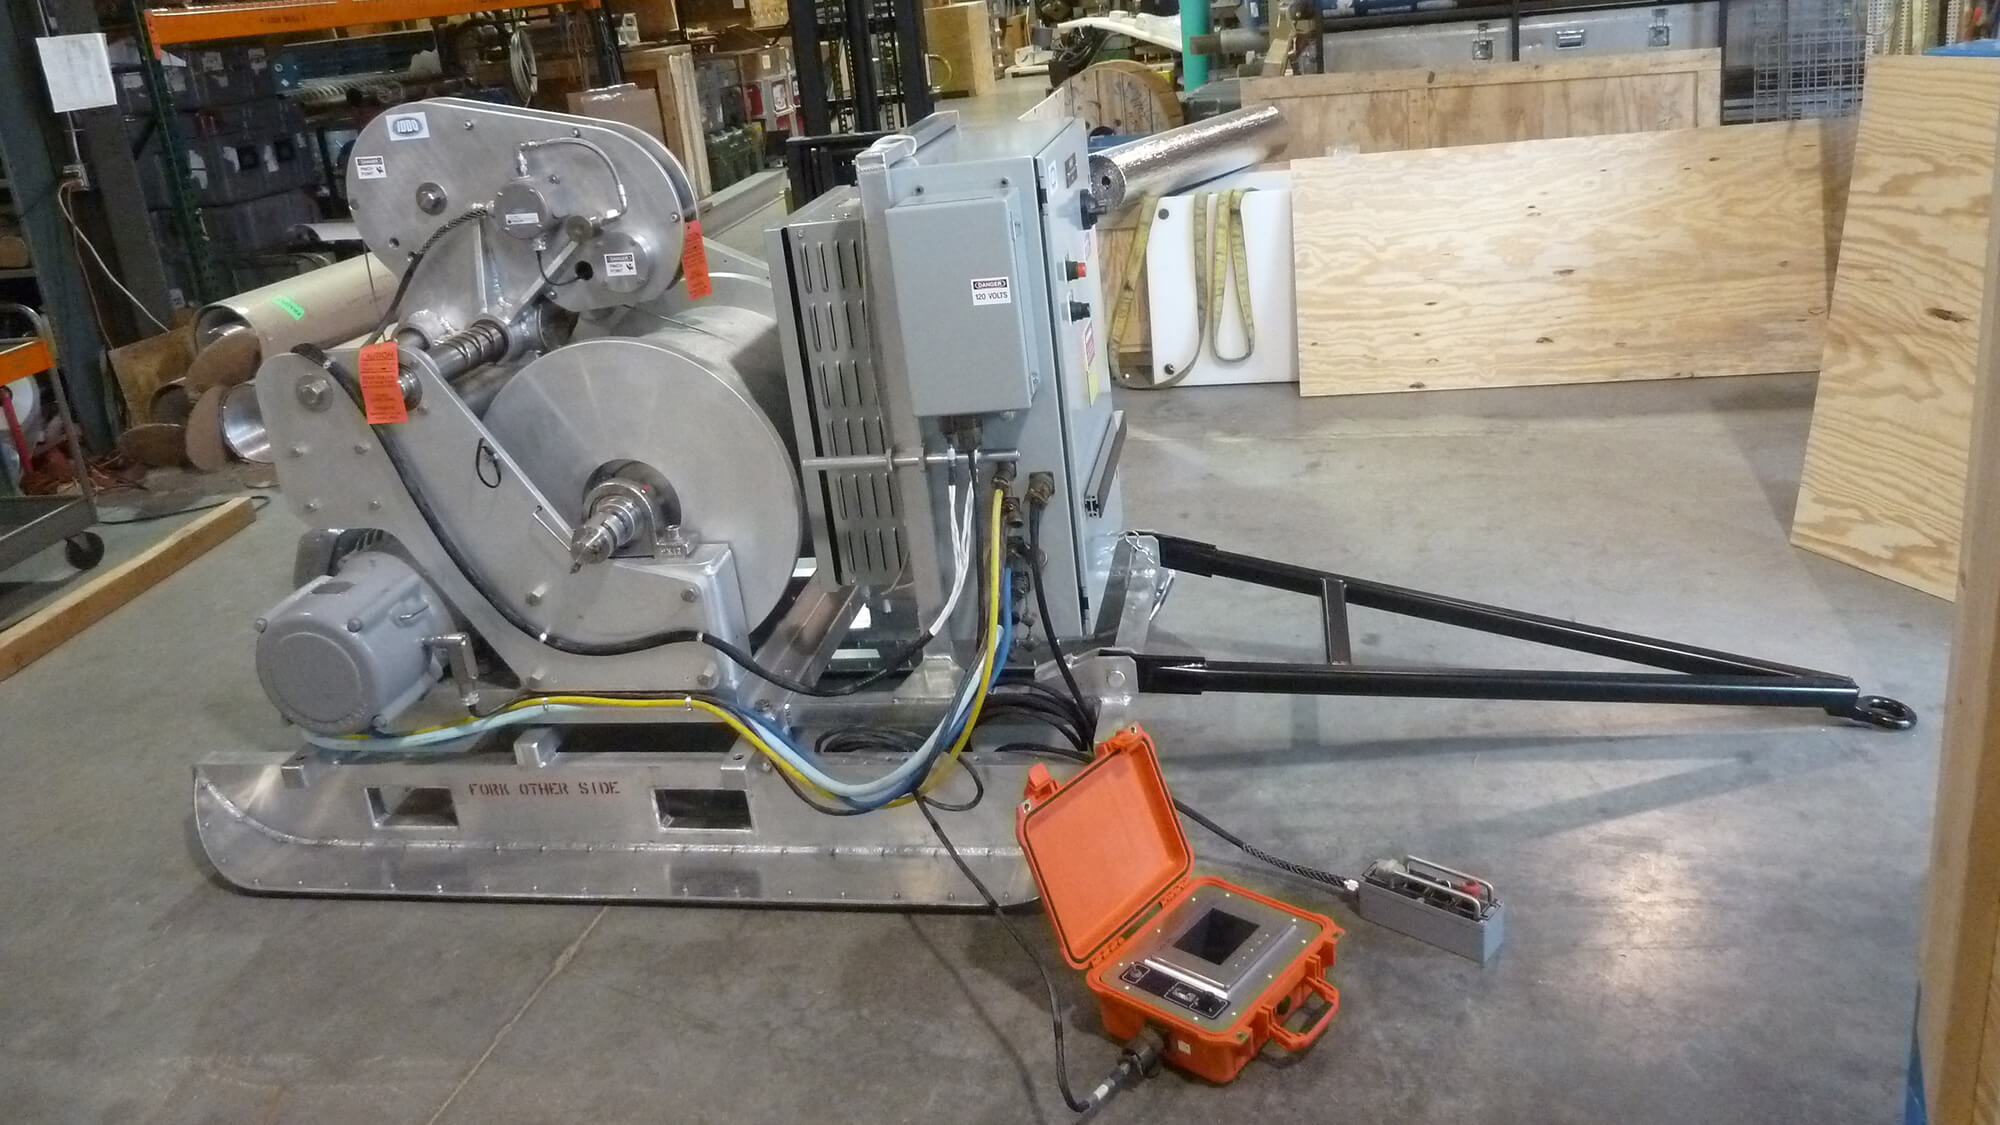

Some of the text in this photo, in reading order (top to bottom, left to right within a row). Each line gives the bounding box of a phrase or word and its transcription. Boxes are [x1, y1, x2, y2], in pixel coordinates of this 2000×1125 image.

[978, 280, 1001, 288] DANGER
[988, 291, 1008, 300] VOLTS
[468, 781, 621, 796] FORK OTHER SIDE
